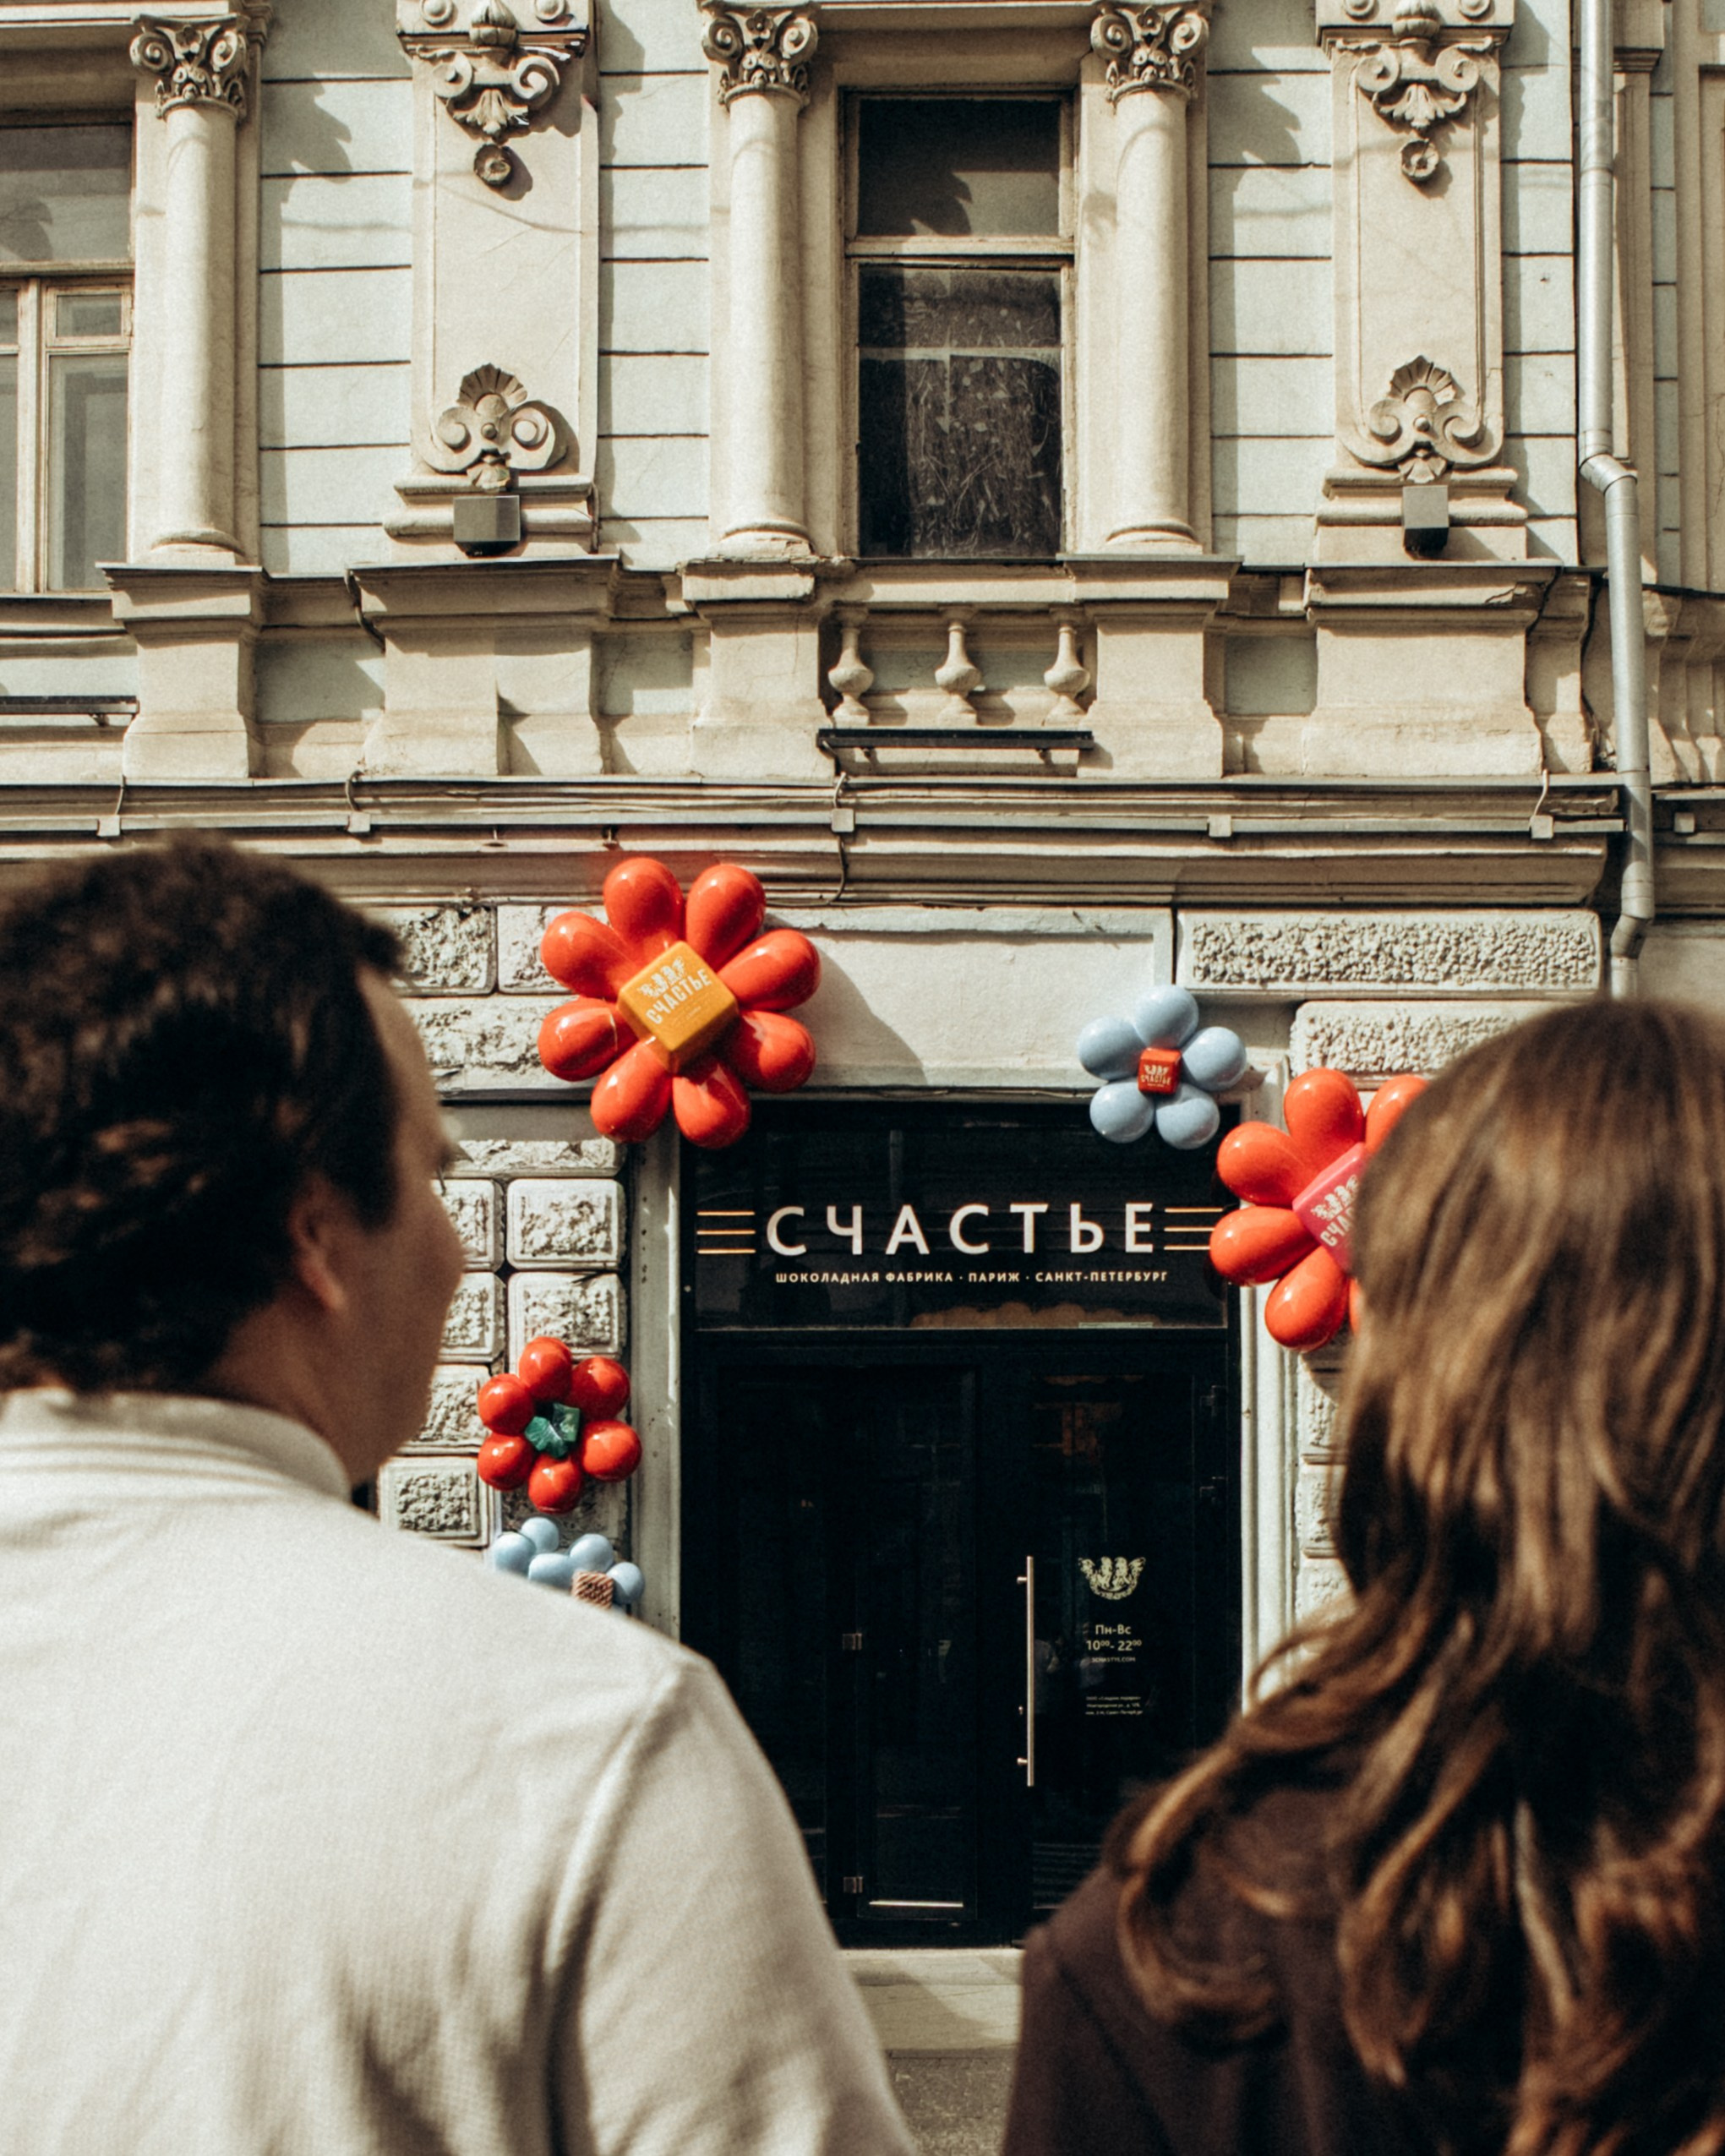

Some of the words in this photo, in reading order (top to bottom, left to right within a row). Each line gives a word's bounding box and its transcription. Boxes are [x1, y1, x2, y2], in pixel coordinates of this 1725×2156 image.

[646, 969, 712, 1024] СЧАСТЬЕ
[1140, 1074, 1172, 1086] СЧАСТЬЕ
[767, 1203, 1154, 1256] СЧАСТЬЕ
[775, 1272, 880, 1284] ШОКОЛАДНАЯ
[885, 1271, 953, 1282] ФАБРИКА
[969, 1272, 1020, 1282] ПАРИЖ
[1035, 1271, 1168, 1282] САНКТ-ПЕТЕРБУРГ
[1095, 1624, 1131, 1635] Пн-Вс
